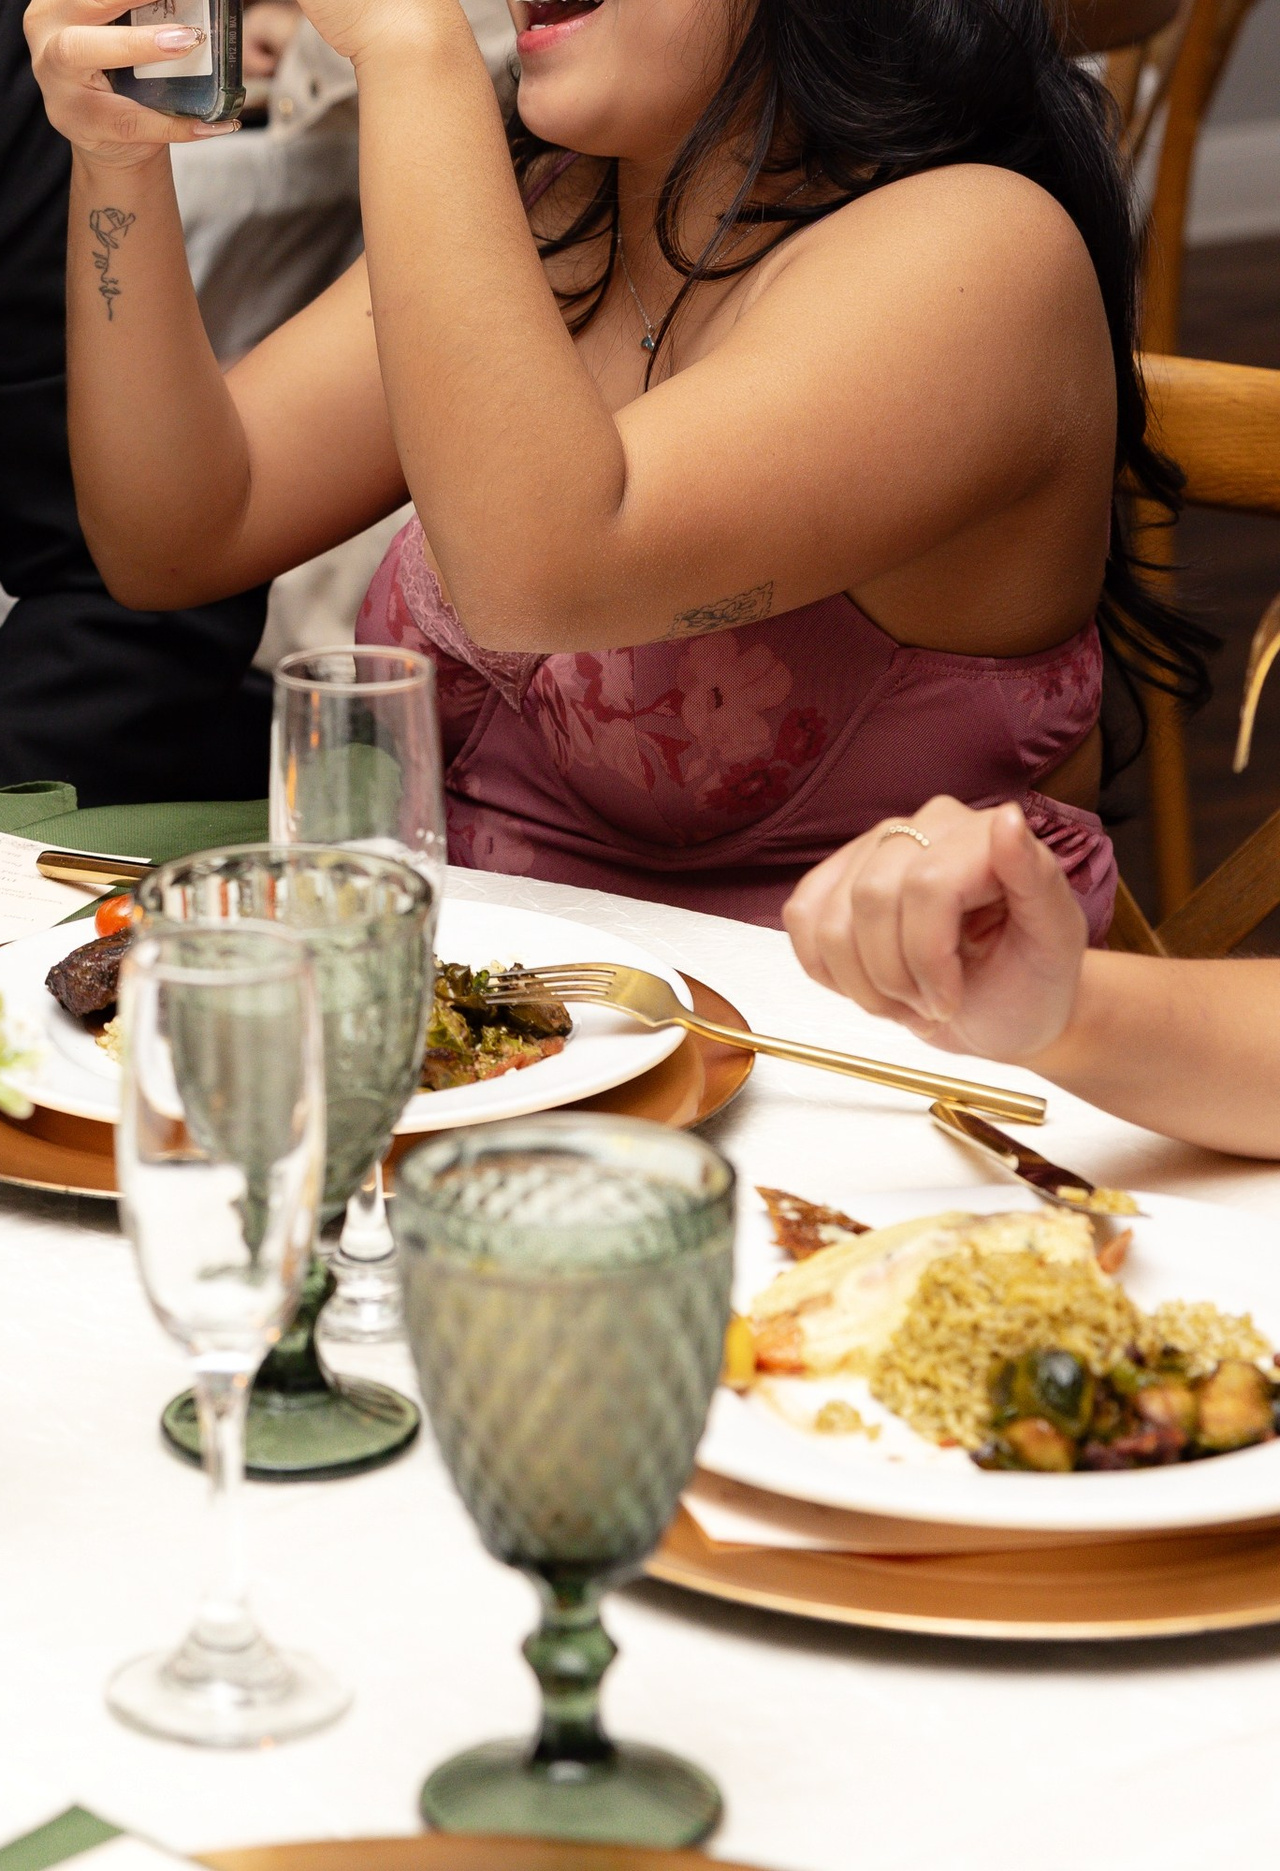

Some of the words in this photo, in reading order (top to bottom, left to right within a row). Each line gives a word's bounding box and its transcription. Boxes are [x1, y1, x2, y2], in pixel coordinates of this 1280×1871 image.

[229, 15, 237, 28] MAX
[228, 30, 237, 44] PRO
[228, 47, 237, 63] IP12
